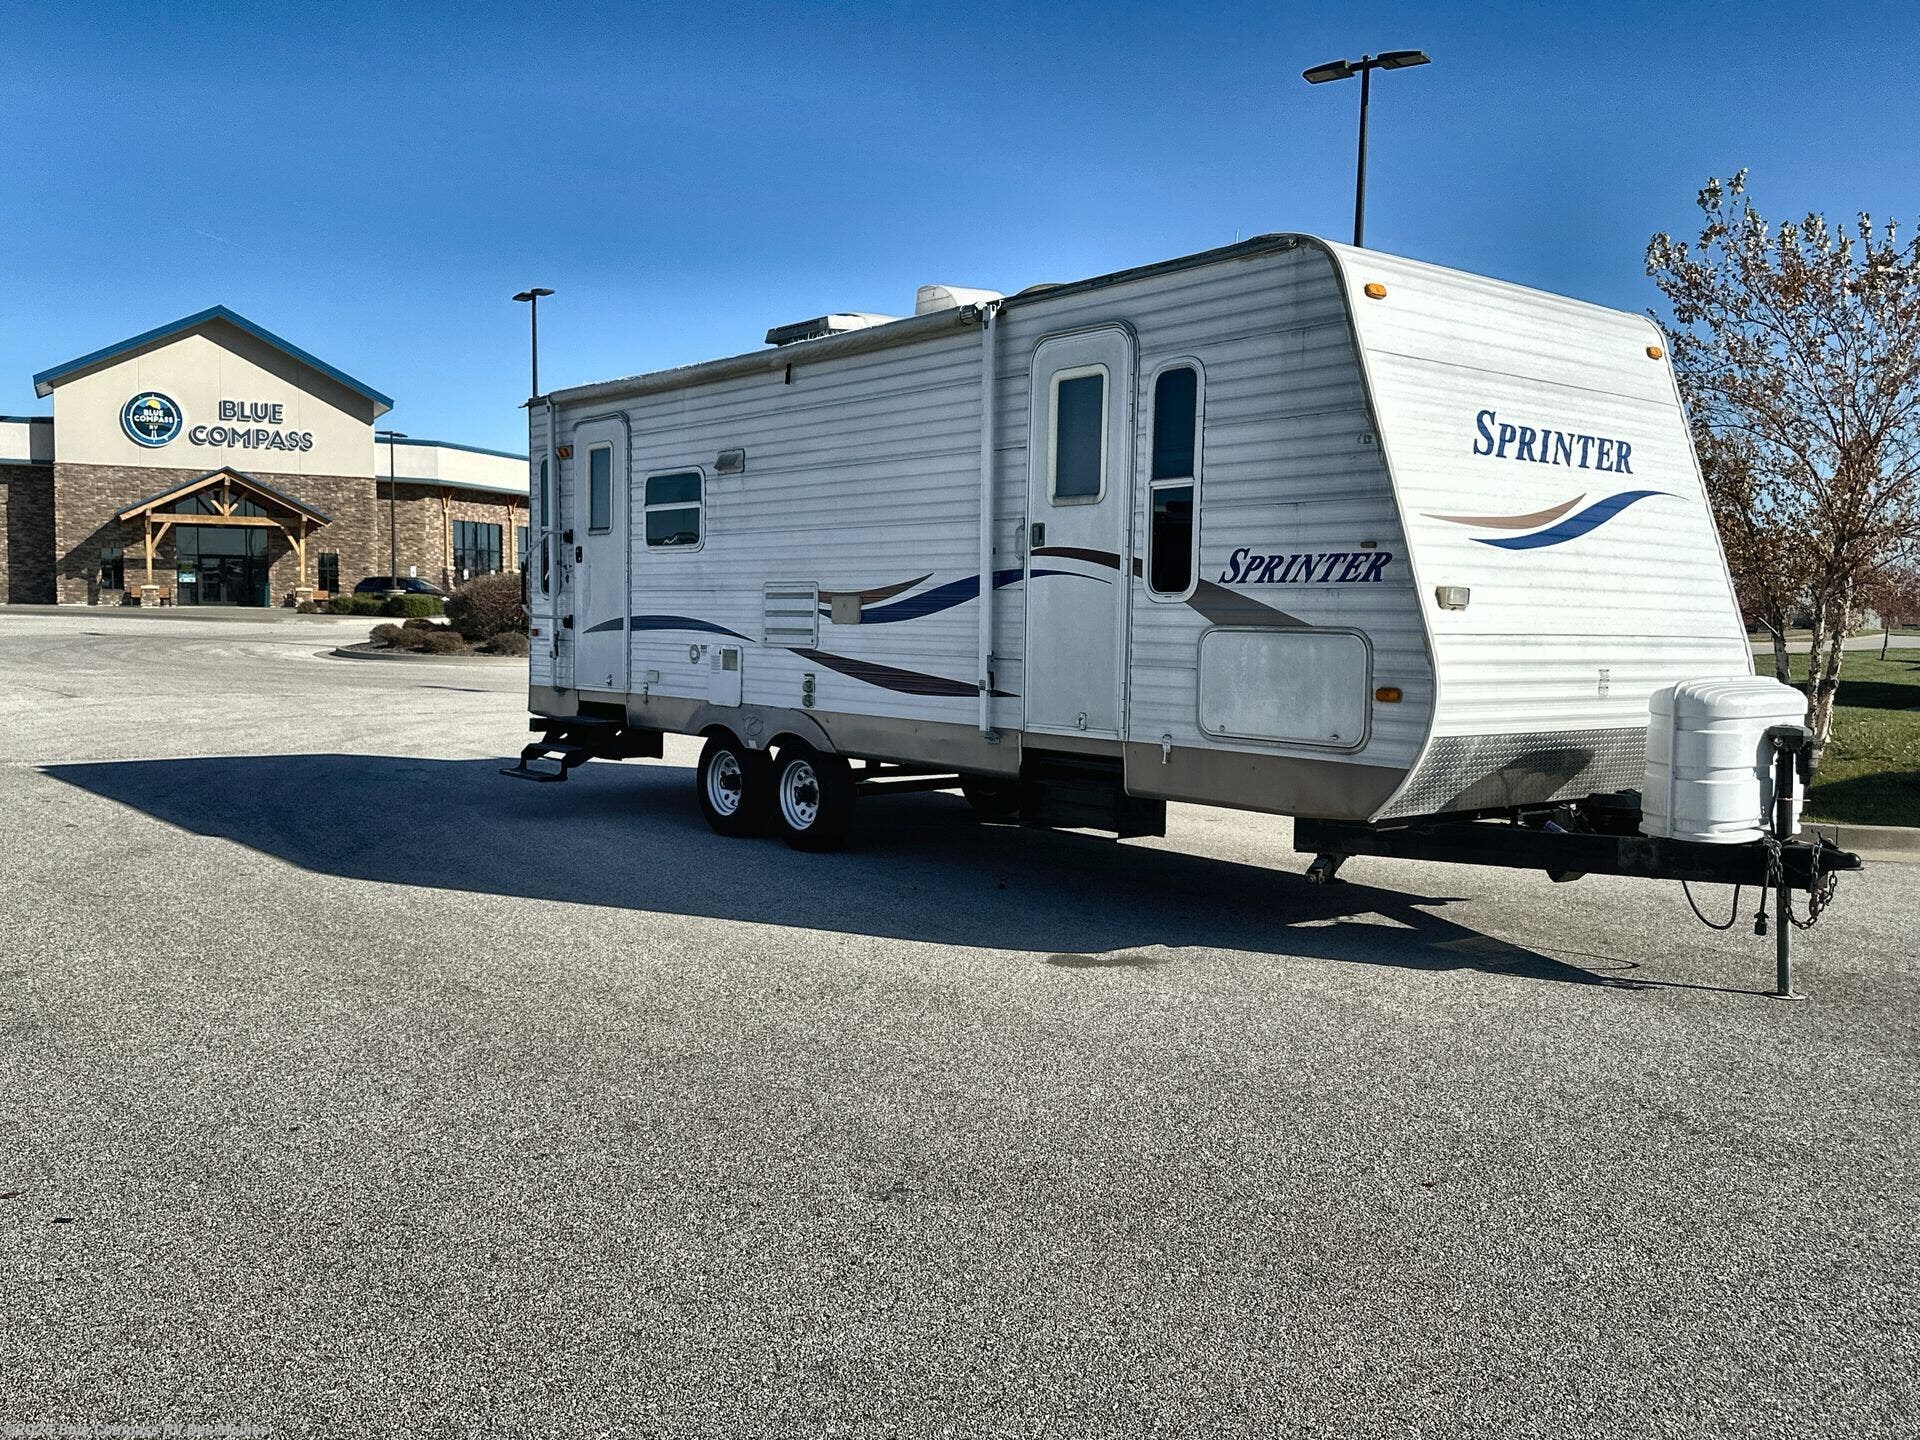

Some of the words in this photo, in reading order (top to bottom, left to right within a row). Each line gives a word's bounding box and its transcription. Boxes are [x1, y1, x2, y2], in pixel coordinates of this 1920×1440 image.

[133, 415, 173, 423] COMPASS
[219, 400, 283, 424] BLUE
[188, 425, 313, 452] COMPASS
